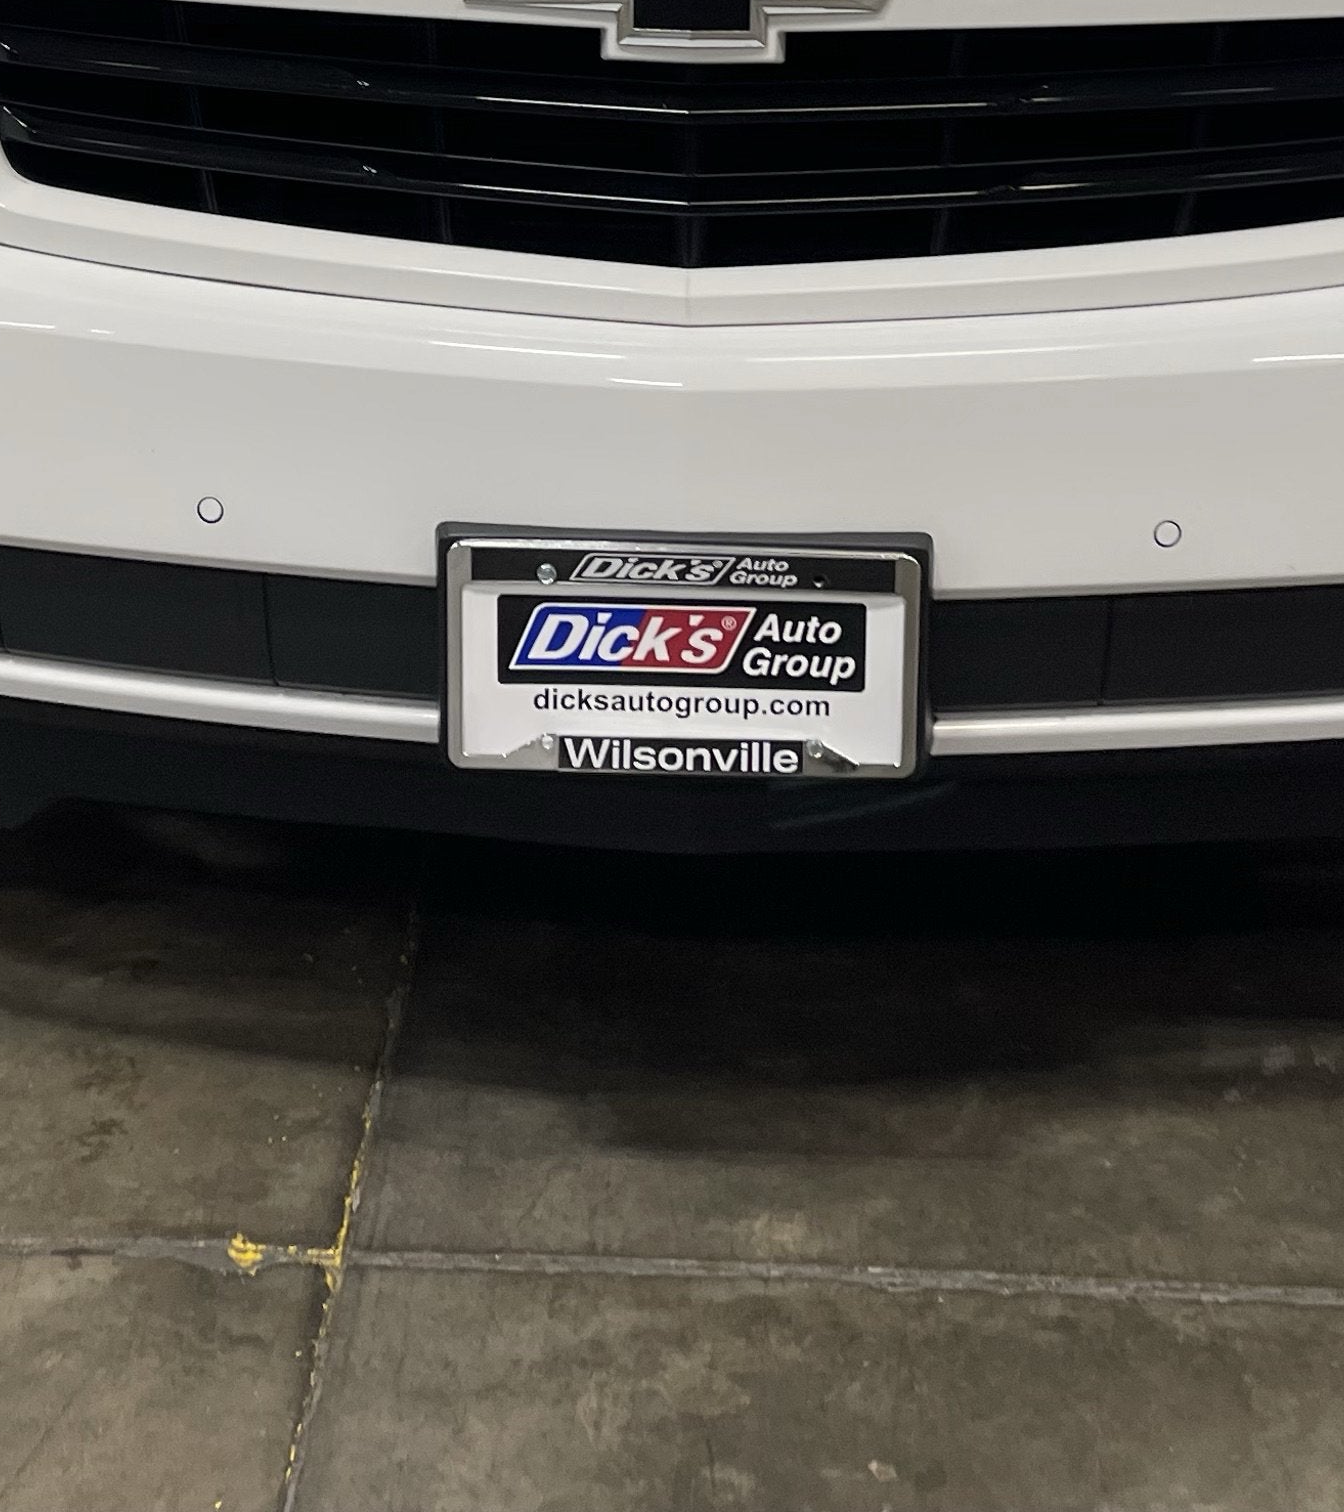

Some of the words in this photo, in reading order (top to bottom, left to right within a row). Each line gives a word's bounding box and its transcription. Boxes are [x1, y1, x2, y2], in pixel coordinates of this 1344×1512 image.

[729, 570, 798, 588] Group
[736, 557, 790, 573] Auto
[754, 613, 842, 644] Auto
[741, 648, 856, 686] Group
[533, 689, 831, 719] dicksautogroup.com
[564, 737, 800, 774] Wilsonville
